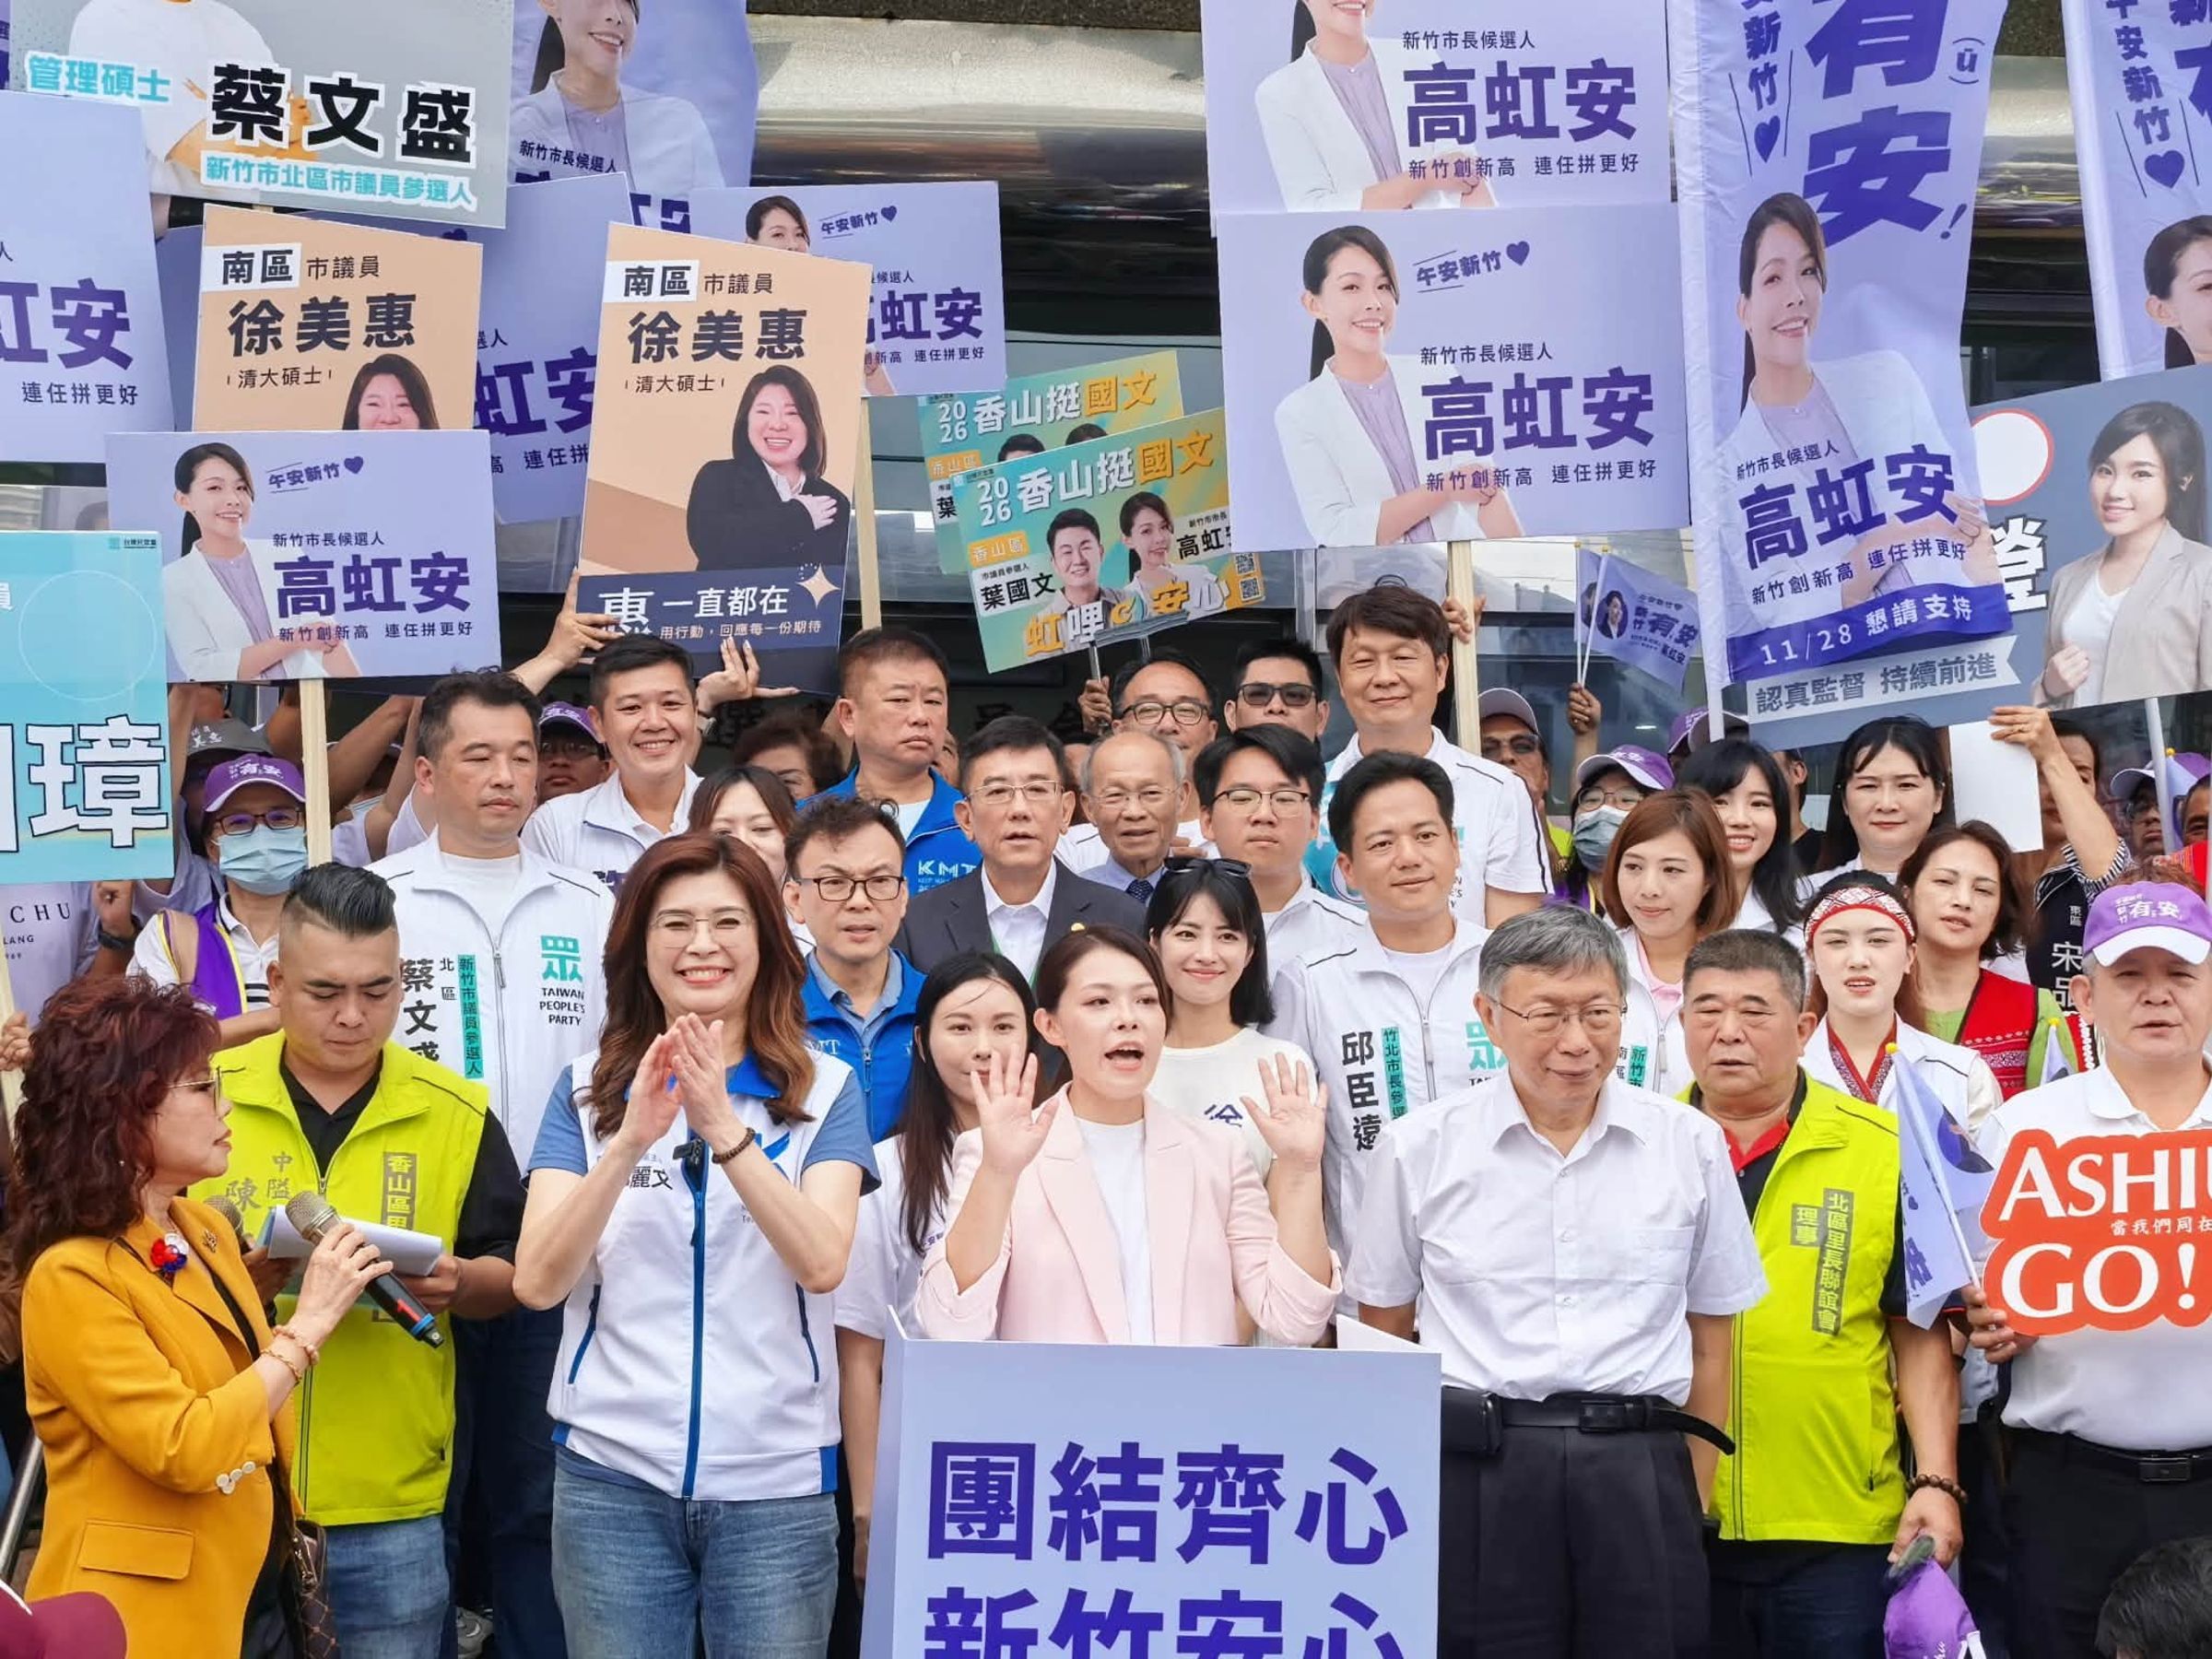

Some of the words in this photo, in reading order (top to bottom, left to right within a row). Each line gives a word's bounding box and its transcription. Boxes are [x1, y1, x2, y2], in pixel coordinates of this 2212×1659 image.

[1403, 30, 1536, 50] 新竹市長候選人
[1742, 0, 1783, 111] 新竹
[28, 55, 171, 103] 管理碩士
[211, 63, 472, 164] 蔡文盛
[1403, 58, 1637, 147] 高虹安
[519, 139, 618, 174] 新竹市長候選人
[1408, 158, 1516, 180] 新竹創新高
[1535, 154, 1640, 175] 連任拼更好
[206, 155, 474, 205] 新竹市北區市議員參選人
[820, 212, 878, 235] 午安新竹
[222, 250, 294, 286] 南區
[307, 255, 381, 280] 市議員
[624, 265, 691, 297] 南區
[703, 274, 773, 295] 市議員
[872, 270, 914, 284] 候選人
[1417, 249, 1502, 288] 午安新竹
[228, 293, 418, 359] 徐美惠
[866, 287, 982, 344] 虹安
[627, 308, 808, 365] 徐美惠
[1420, 342, 1554, 366] 新竹市長候選人
[22, 381, 139, 407] 連任拼更好
[238, 368, 324, 390] 清大碩士
[635, 375, 716, 394] 清大碩士
[938, 400, 967, 424] 20
[972, 370, 1159, 435] 香山挺國文
[1421, 367, 1654, 461] 高虹安
[939, 421, 969, 443] 26
[268, 462, 342, 491] 午安新竹
[1017, 429, 1216, 514] 香山挺國文
[1425, 467, 1534, 492] 新竹創新高
[1551, 459, 1657, 486] 連任拼更好
[1736, 438, 1841, 481] 新竹市長候選人
[977, 477, 1010, 504] 20
[1738, 443, 1964, 571] 高虹安
[979, 499, 1013, 528] 26
[273, 530, 384, 548] 新竹市長候選人
[1176, 522, 1232, 561] 高虹
[274, 551, 471, 618] 高虹安
[1750, 560, 1854, 606] 新竹創新高
[1867, 537, 1967, 571] 連任拼更好
[662, 585, 791, 619] 一直都在
[980, 572, 1057, 612] 葉國文
[278, 625, 369, 641] 新竹創新高
[384, 621, 474, 639] 連任拼更好
[660, 619, 822, 641] 用行動，回應每一份期待
[1761, 623, 1855, 666] 11/28
[1865, 594, 1973, 641] 懇請支持
[1755, 670, 1866, 714] 認真監督
[1880, 652, 1997, 694] 持續前進
[0, 713, 169, 853] 璋
[10, 902, 71, 924] CHU
[439, 957, 456, 1001] 北區
[541, 986, 585, 1000] TAIWAN
[459, 957, 483, 1077] 新竹市議員參選人
[539, 1001, 585, 1013] PEOPLE'S
[547, 1014, 582, 1026] PARTY
[1342, 1030, 1383, 1151] 邱臣遠
[627, 1165, 674, 1191] 麗文
[1998, 1146, 2212, 1222] ASHI
[2111, 1216, 2212, 1237] 當我們同在
[2001, 1241, 2196, 1319] GO!
[927, 1441, 1408, 1565] 團結齊心
